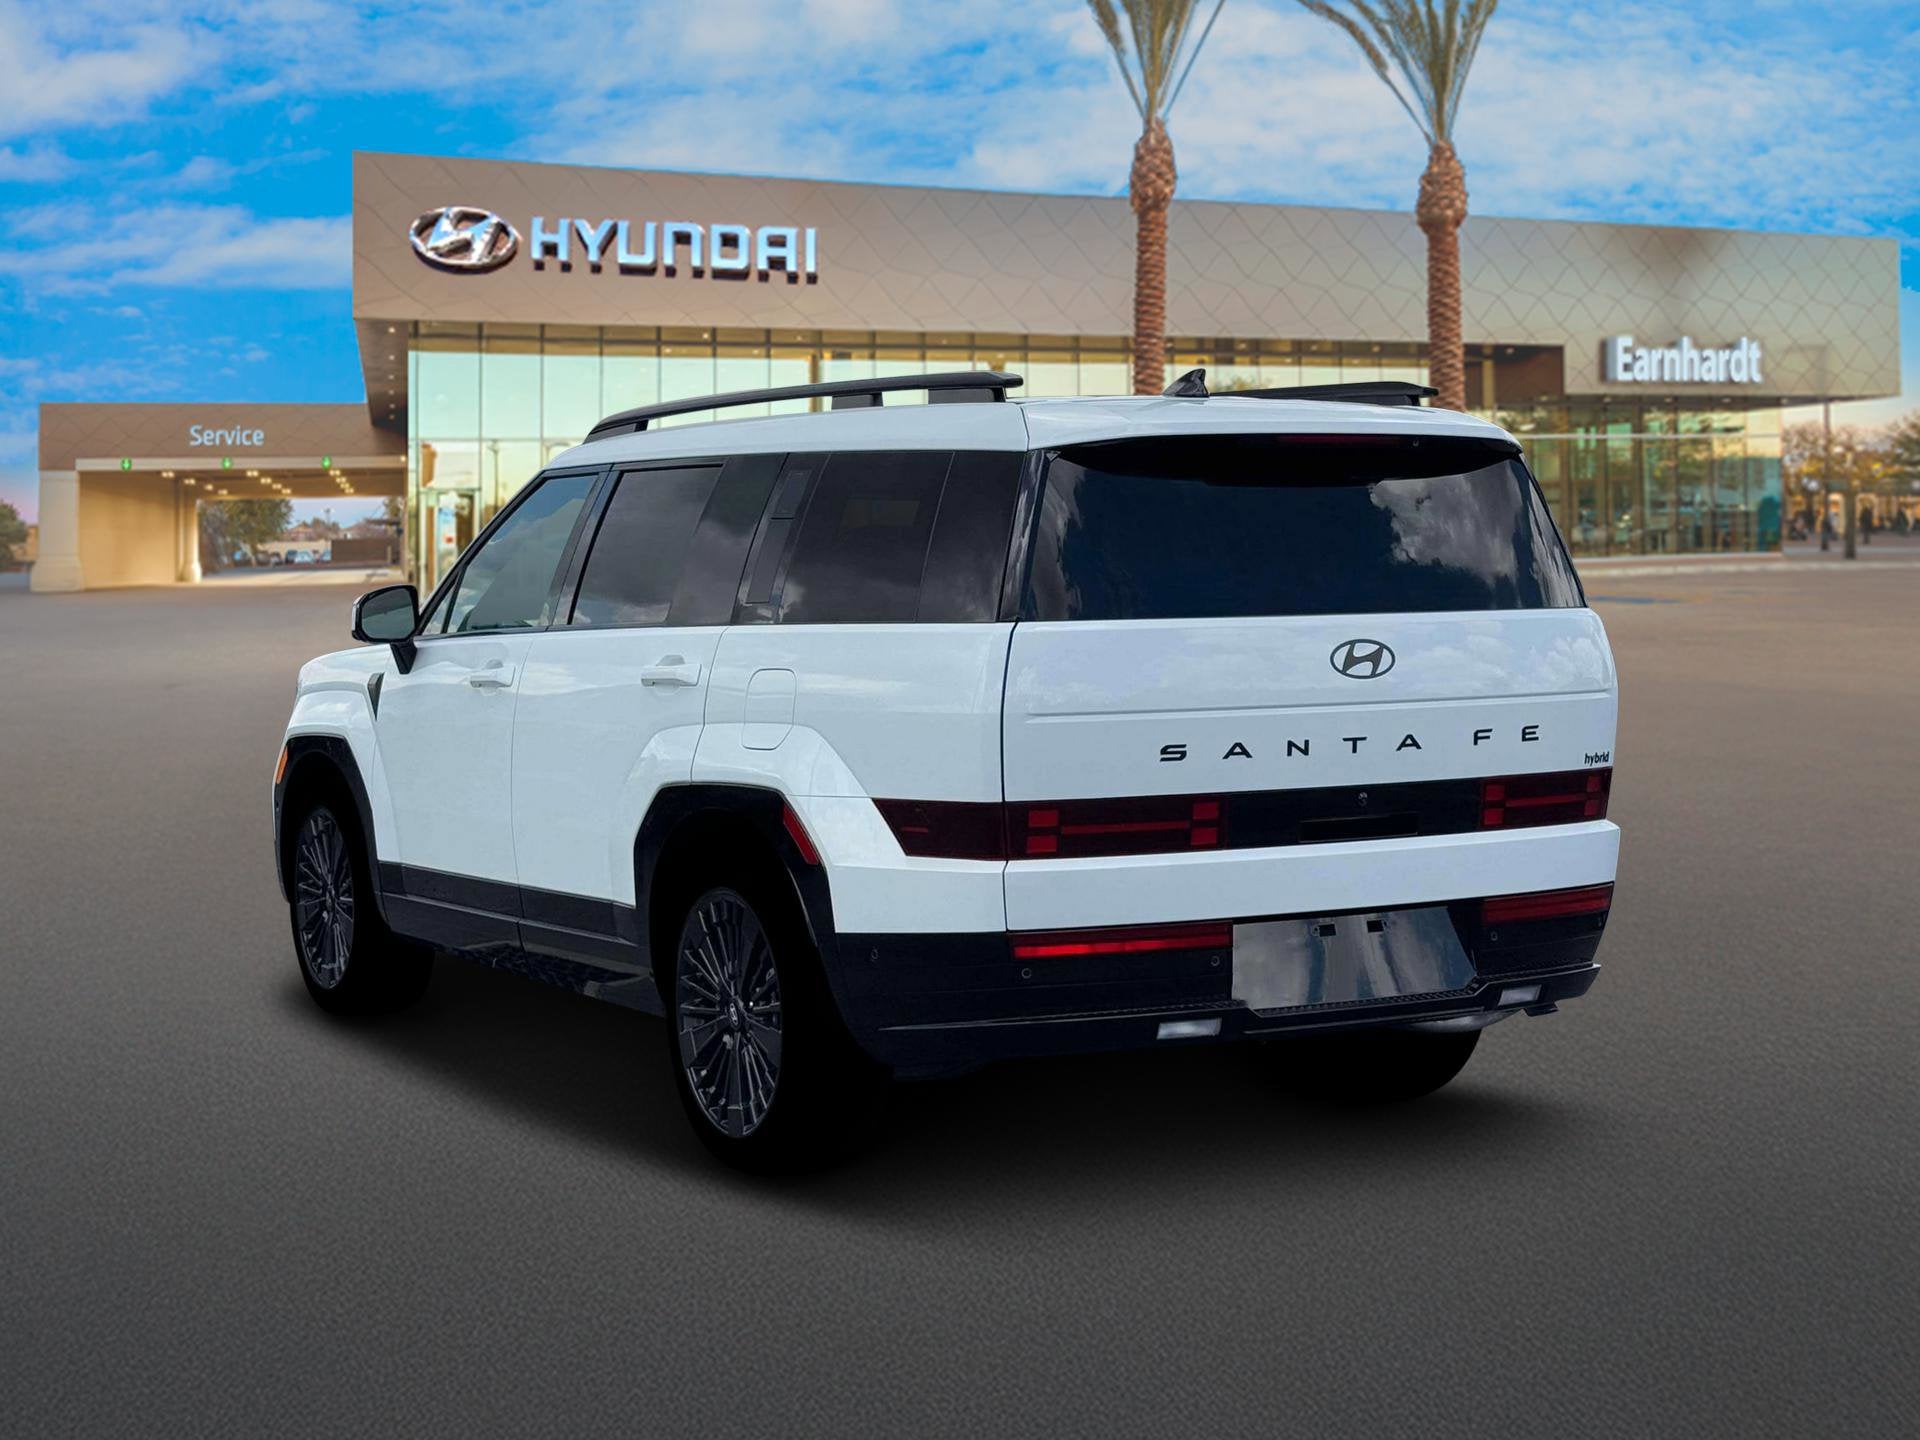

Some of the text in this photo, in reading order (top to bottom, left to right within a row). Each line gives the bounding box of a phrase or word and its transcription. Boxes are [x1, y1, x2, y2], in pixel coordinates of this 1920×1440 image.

[531, 216, 818, 281] HYUNDAI
[1608, 334, 1763, 382] Earnhardt
[189, 424, 265, 446] Service
[1159, 723, 1541, 763] SANTA FE
[1584, 751, 1610, 767] hybrid
